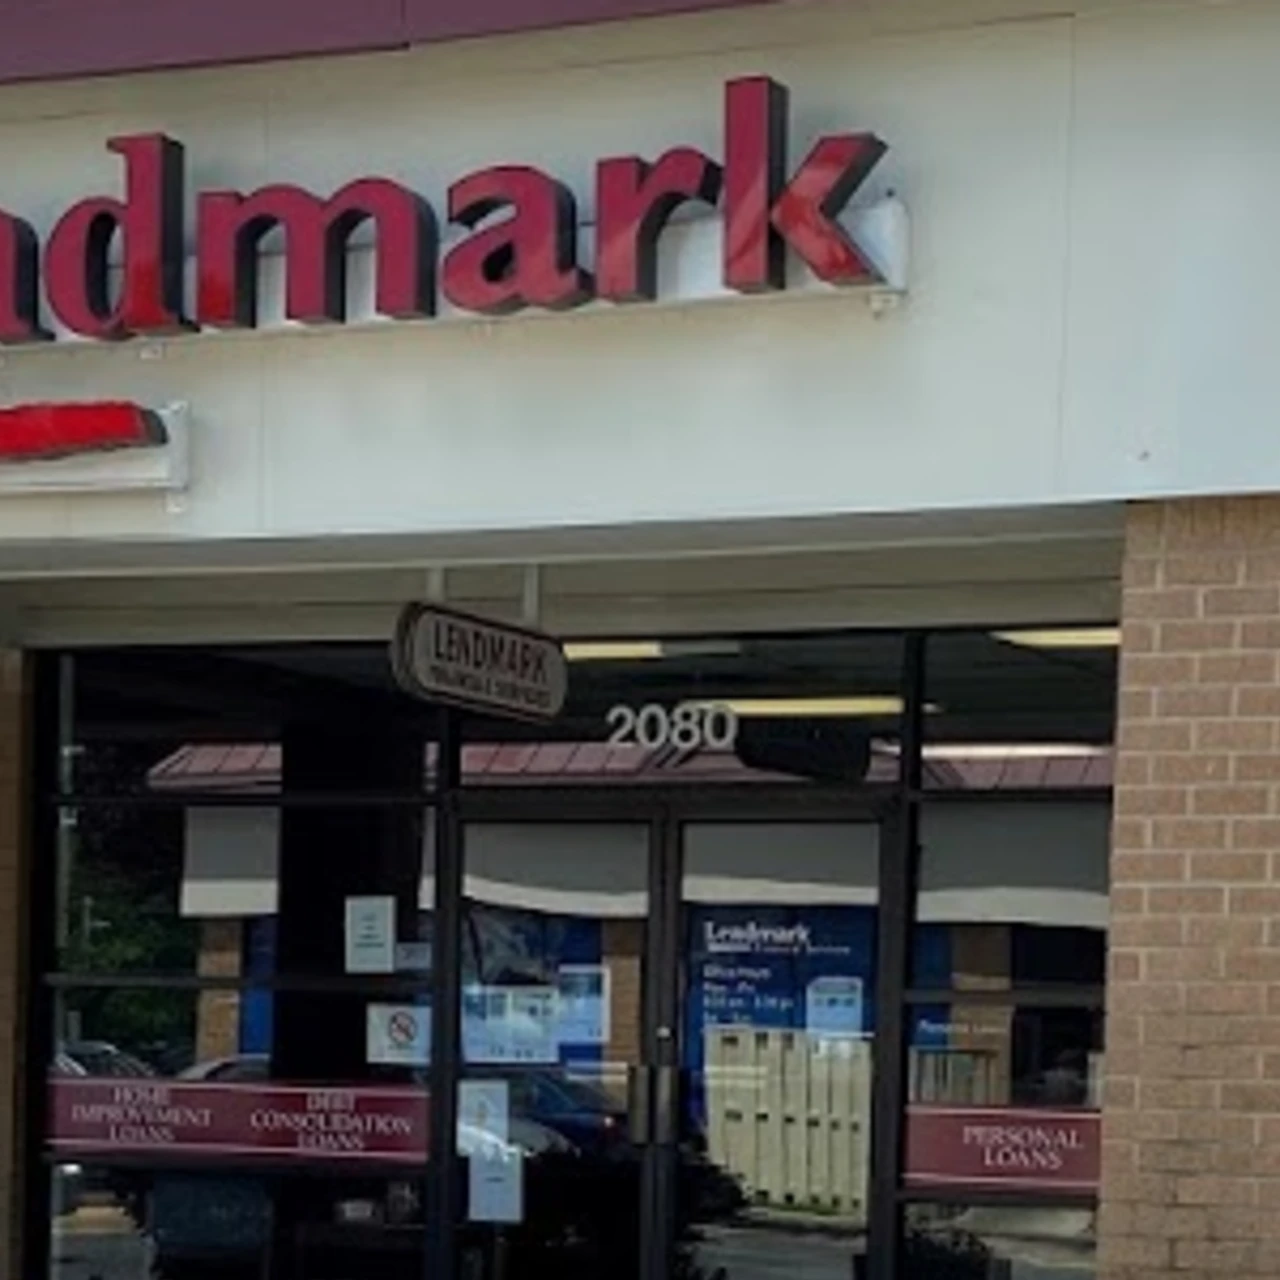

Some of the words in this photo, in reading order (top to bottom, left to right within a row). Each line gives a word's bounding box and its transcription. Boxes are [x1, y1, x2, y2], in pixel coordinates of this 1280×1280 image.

[434, 619, 548, 685] LENDMARK
[606, 703, 739, 749] 2080
[702, 920, 812, 943] Lendmark
[113, 1085, 171, 1106] HOME
[305, 1092, 357, 1112] DEBT
[70, 1104, 213, 1128] IMPROVEMENT
[249, 1108, 413, 1136] CONSOLIDATION
[109, 1124, 176, 1145] LOANS
[297, 1131, 366, 1151] LOANS
[962, 1124, 1085, 1149] PERSONAL
[982, 1145, 1064, 1170] LOANS
